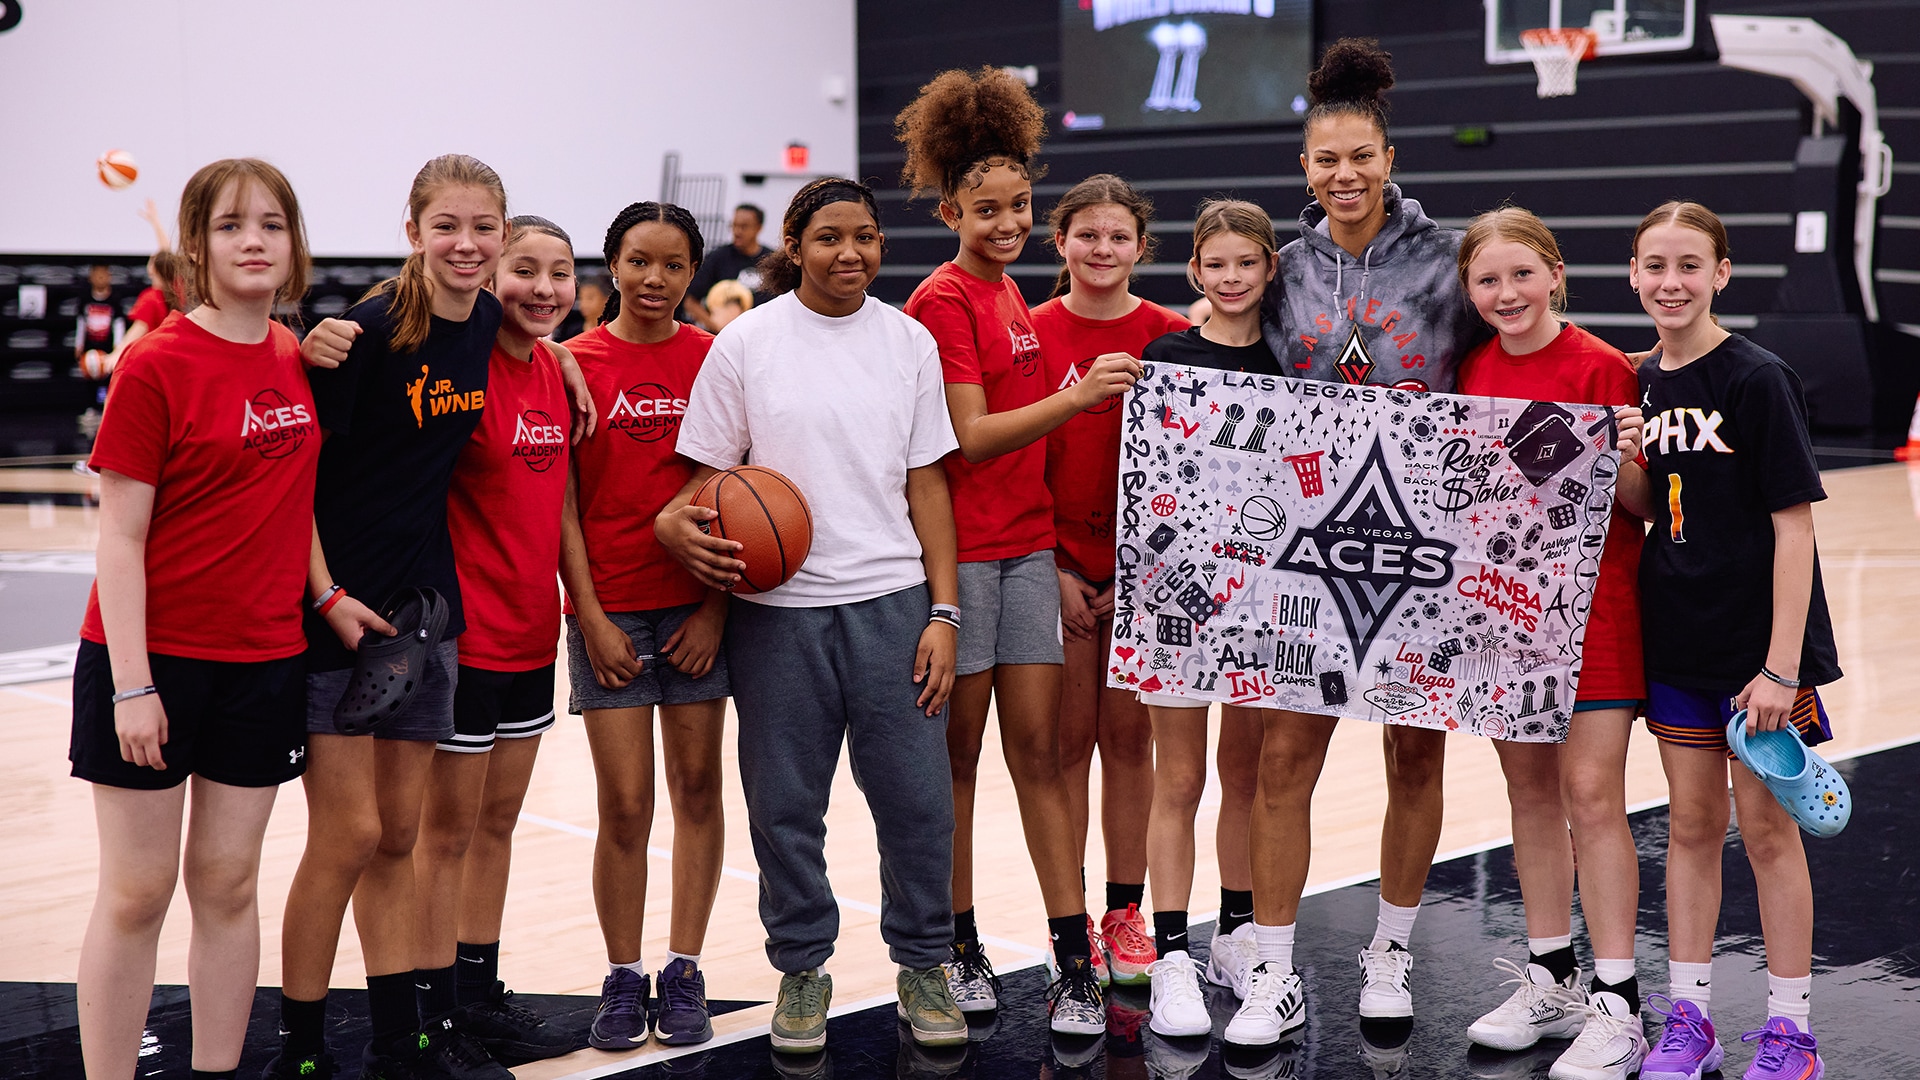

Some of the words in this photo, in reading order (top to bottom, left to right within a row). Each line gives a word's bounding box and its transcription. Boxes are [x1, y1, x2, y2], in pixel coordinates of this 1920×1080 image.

[1294, 313, 1333, 370] LAS
[1346, 296, 1426, 370] VEGAS
[428, 379, 455, 396] JR.
[1222, 373, 1276, 392] LAS
[1284, 379, 1377, 403] VEGAS
[240, 399, 312, 437] ACES
[429, 390, 486, 417] WNB
[607, 389, 688, 420] ACES
[242, 424, 315, 450] ACADEMY
[512, 413, 565, 445] ACES
[1641, 407, 1735, 462] PHX
[512, 445, 565, 457] ACADEMY
[1437, 438, 1504, 476] Raise
[1403, 476, 1438, 487] BACK
[1667, 472, 1687, 543] 1
[1223, 539, 1265, 556] WORLD
[1326, 525, 1355, 535] LAS
[1362, 527, 1414, 540] VEGAS
[1288, 535, 1447, 580] ACES
[1115, 543, 1142, 640] CHAMPS
[1143, 558, 1197, 617] ACES
[1479, 565, 1543, 614] WNBA
[1278, 593, 1322, 630] BACK
[1457, 576, 1537, 632] CHAMPS
[1216, 643, 1269, 671] ALL
[1274, 640, 1317, 676] BACK
[1395, 642, 1423, 664] Las
[1225, 671, 1276, 698] IN!
[1272, 673, 1316, 687] CHAMPS
[1409, 665, 1456, 692] Vegas
